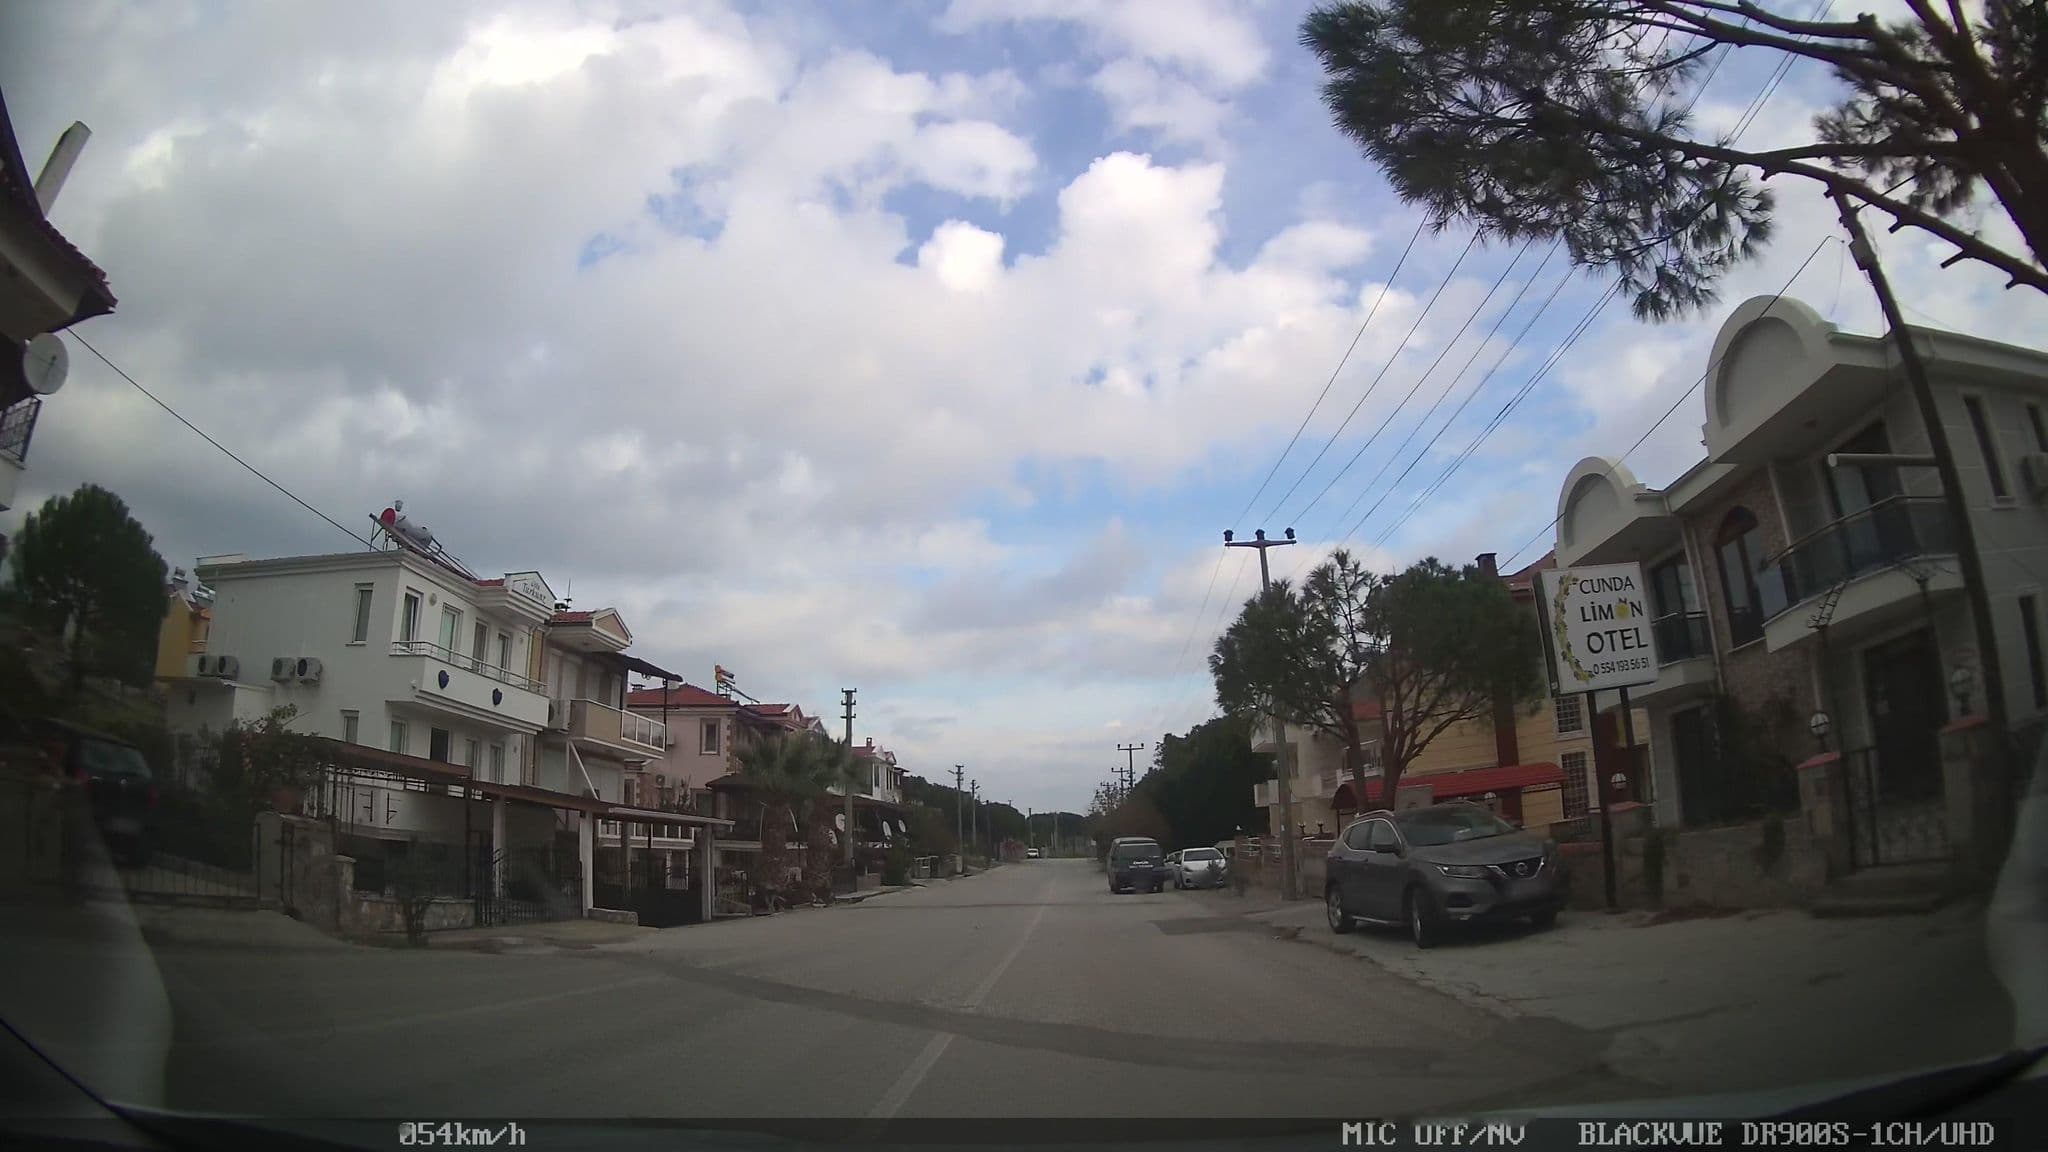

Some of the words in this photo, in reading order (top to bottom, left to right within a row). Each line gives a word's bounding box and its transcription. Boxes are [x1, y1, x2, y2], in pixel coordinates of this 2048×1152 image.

[1579, 575, 1635, 595] CUNDA
[1586, 627, 1648, 654] OTEL
[1600, 661, 1616, 674] 554
